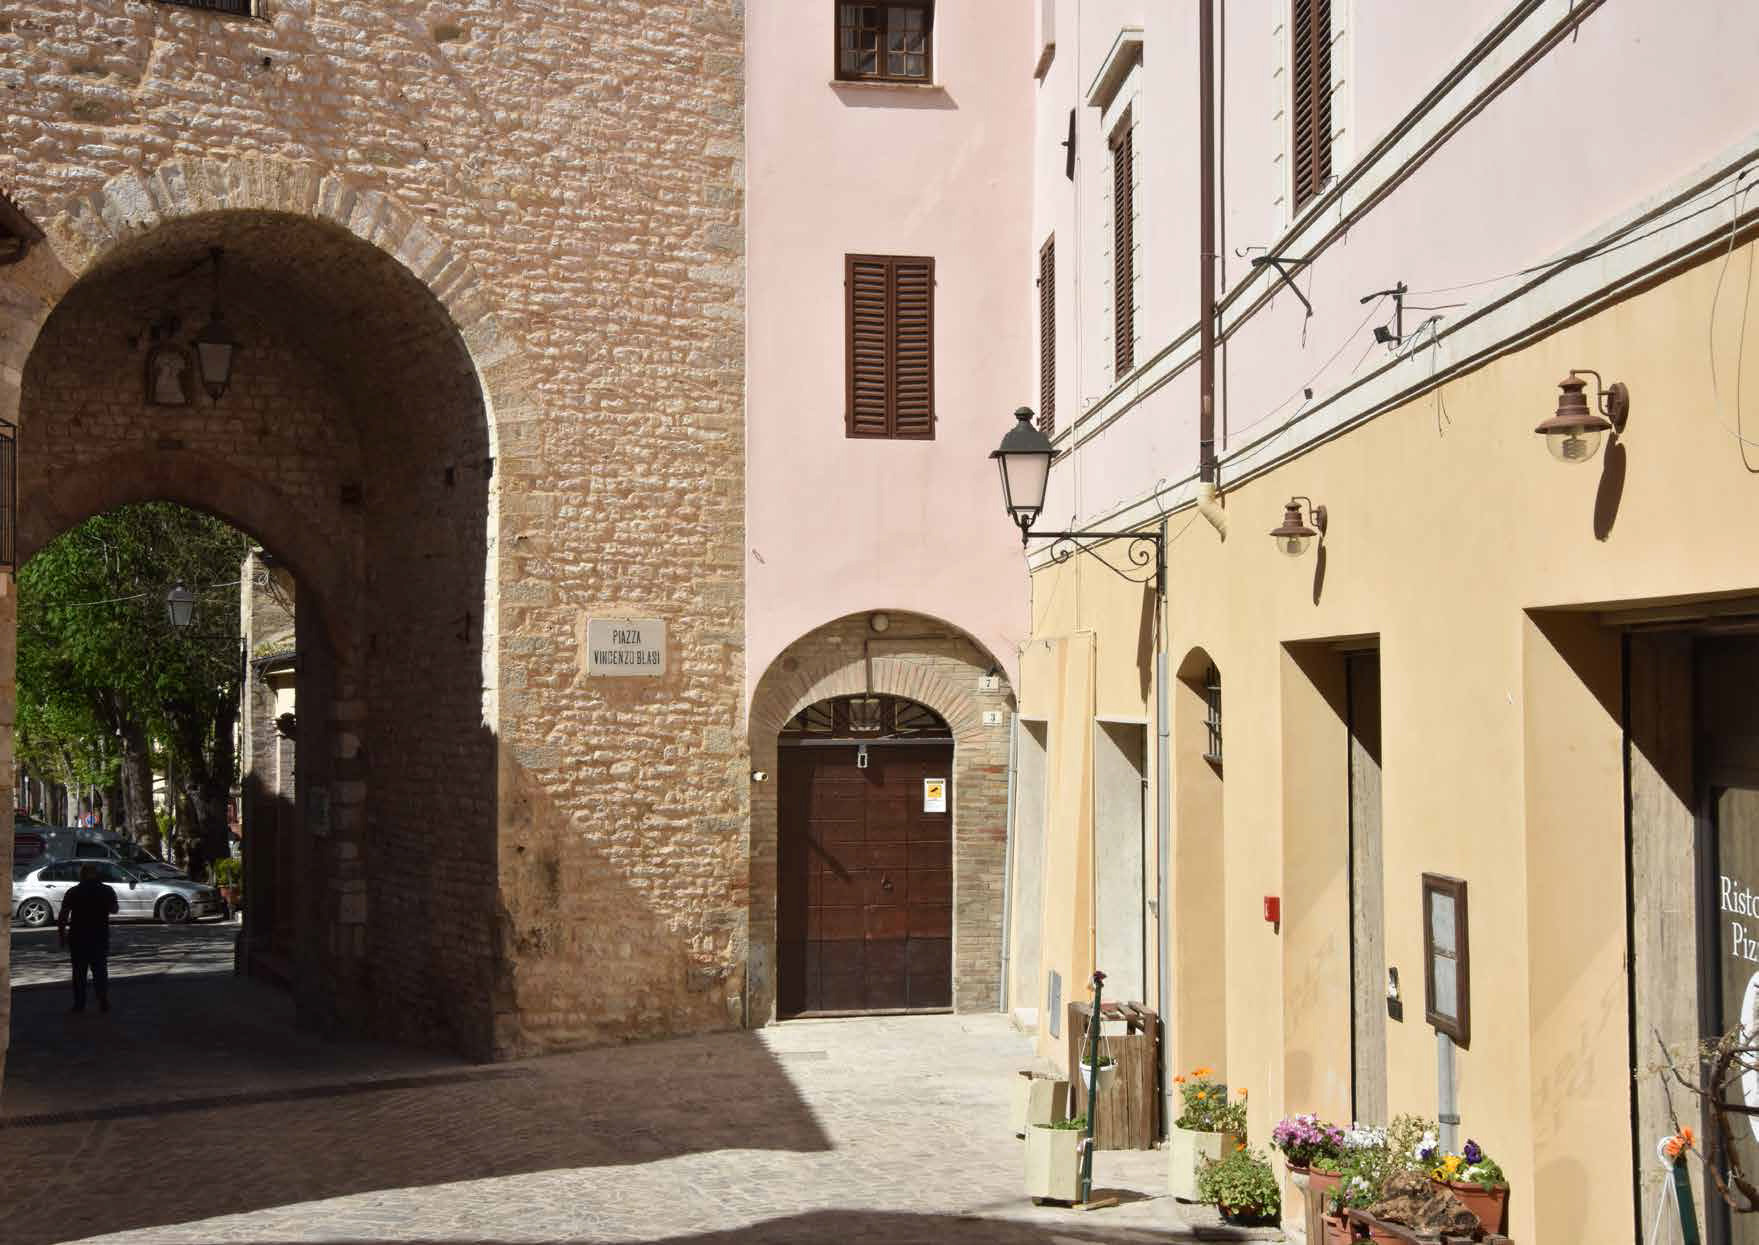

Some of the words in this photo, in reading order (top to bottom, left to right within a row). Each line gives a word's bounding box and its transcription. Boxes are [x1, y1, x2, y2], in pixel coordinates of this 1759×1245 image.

[612, 630, 641, 644] PIAZZA
[594, 650, 635, 665] VINCENZO
[637, 650, 660, 665] BLASI
[1732, 921, 1759, 962] Piz
